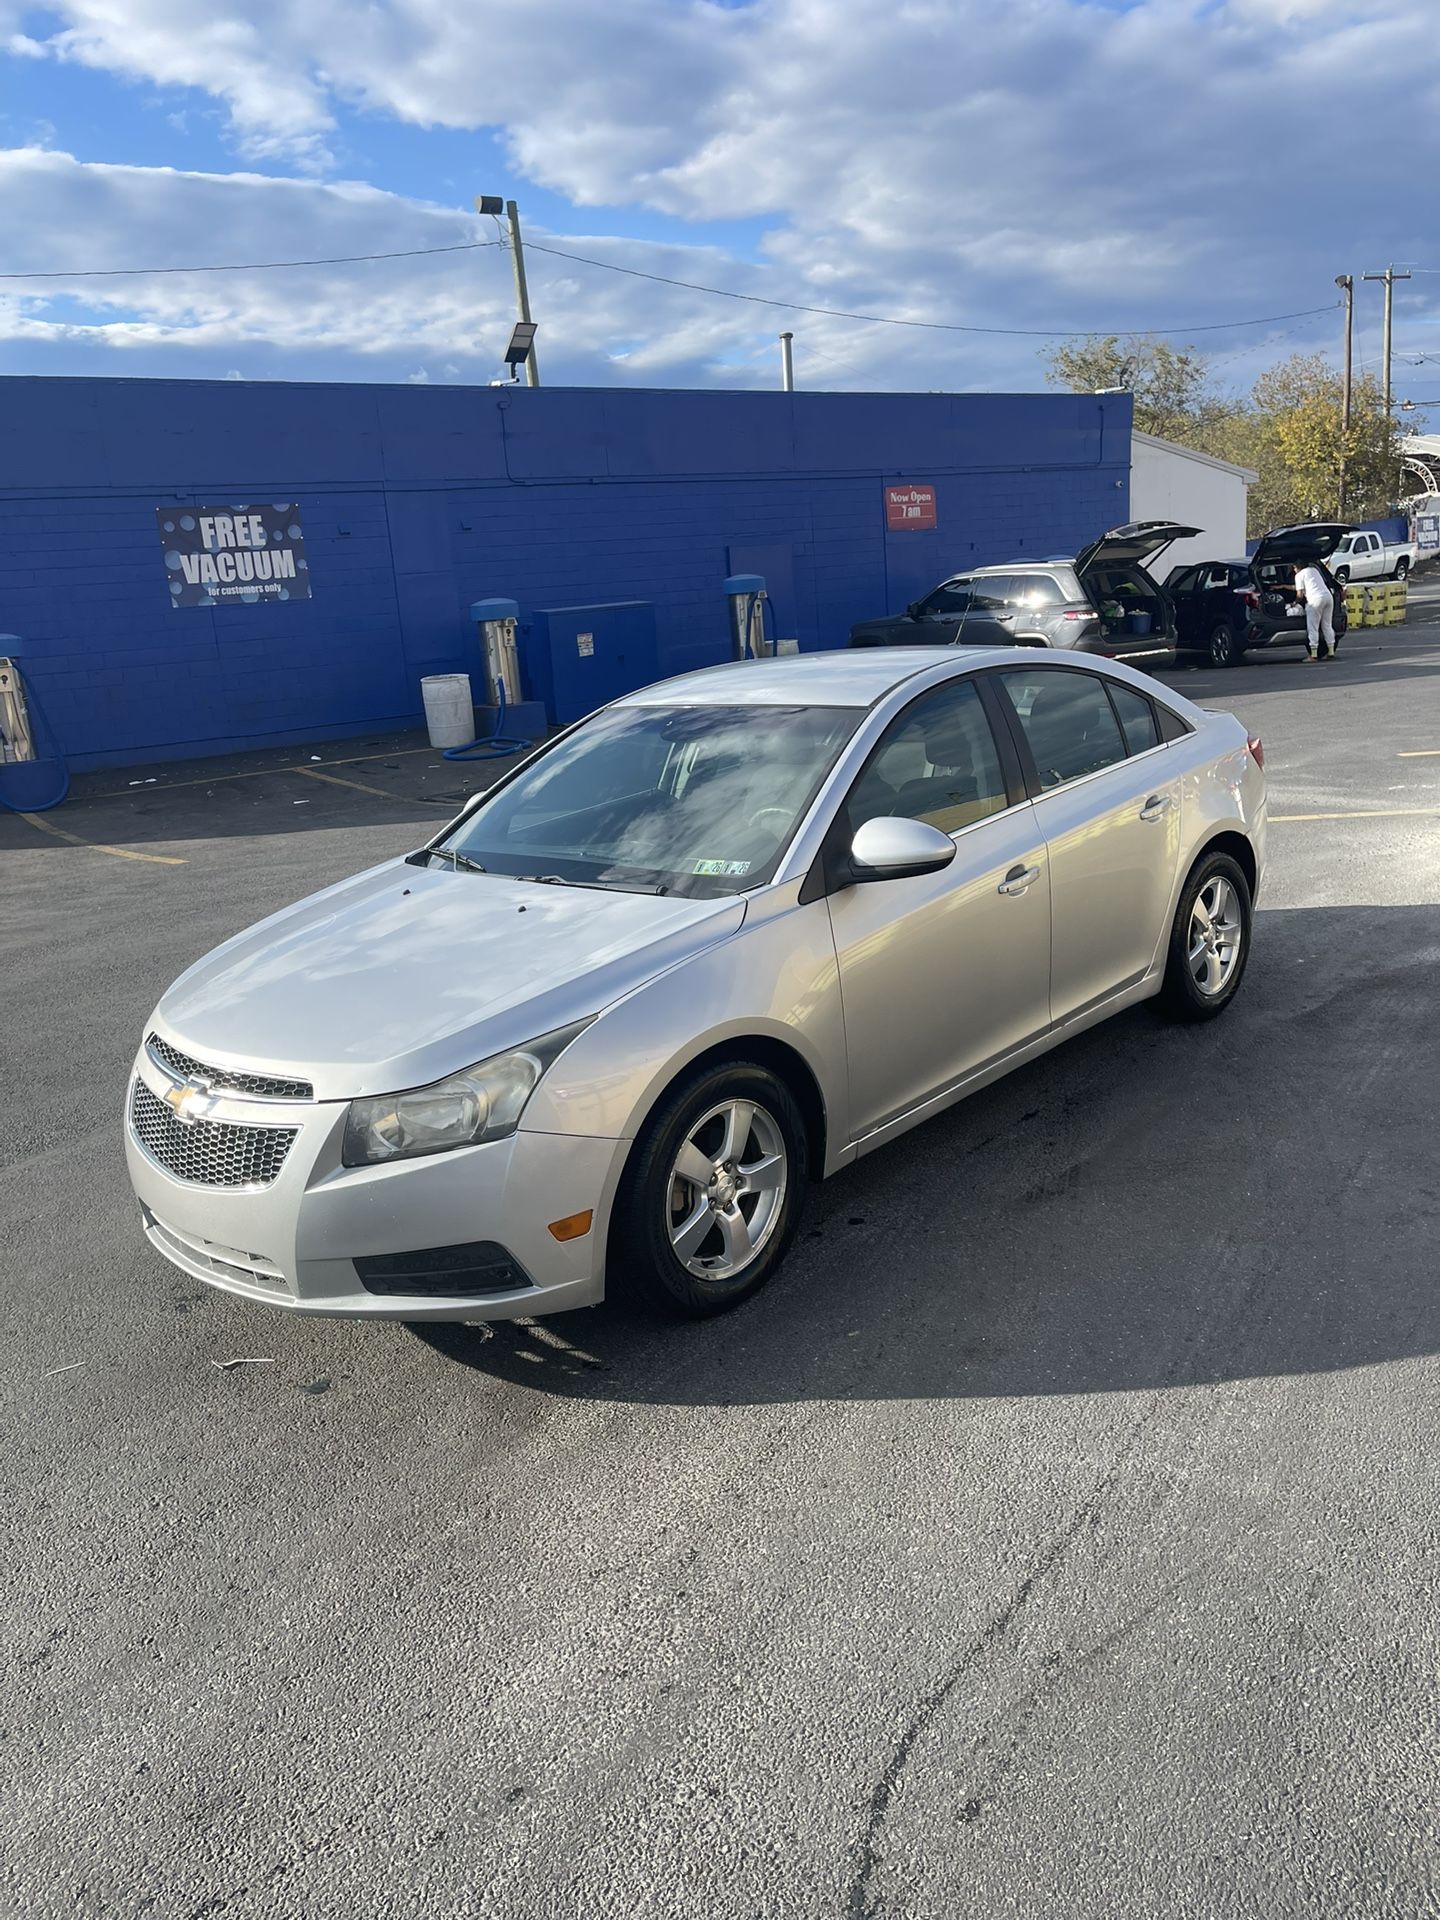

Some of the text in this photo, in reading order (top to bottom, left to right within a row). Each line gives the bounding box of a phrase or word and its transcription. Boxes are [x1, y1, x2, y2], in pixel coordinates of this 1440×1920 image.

[890, 491, 931, 504] Now Open
[200, 515, 267, 549] FREE
[179, 549, 296, 584] VACUUM
[207, 583, 282, 597] for customers only
